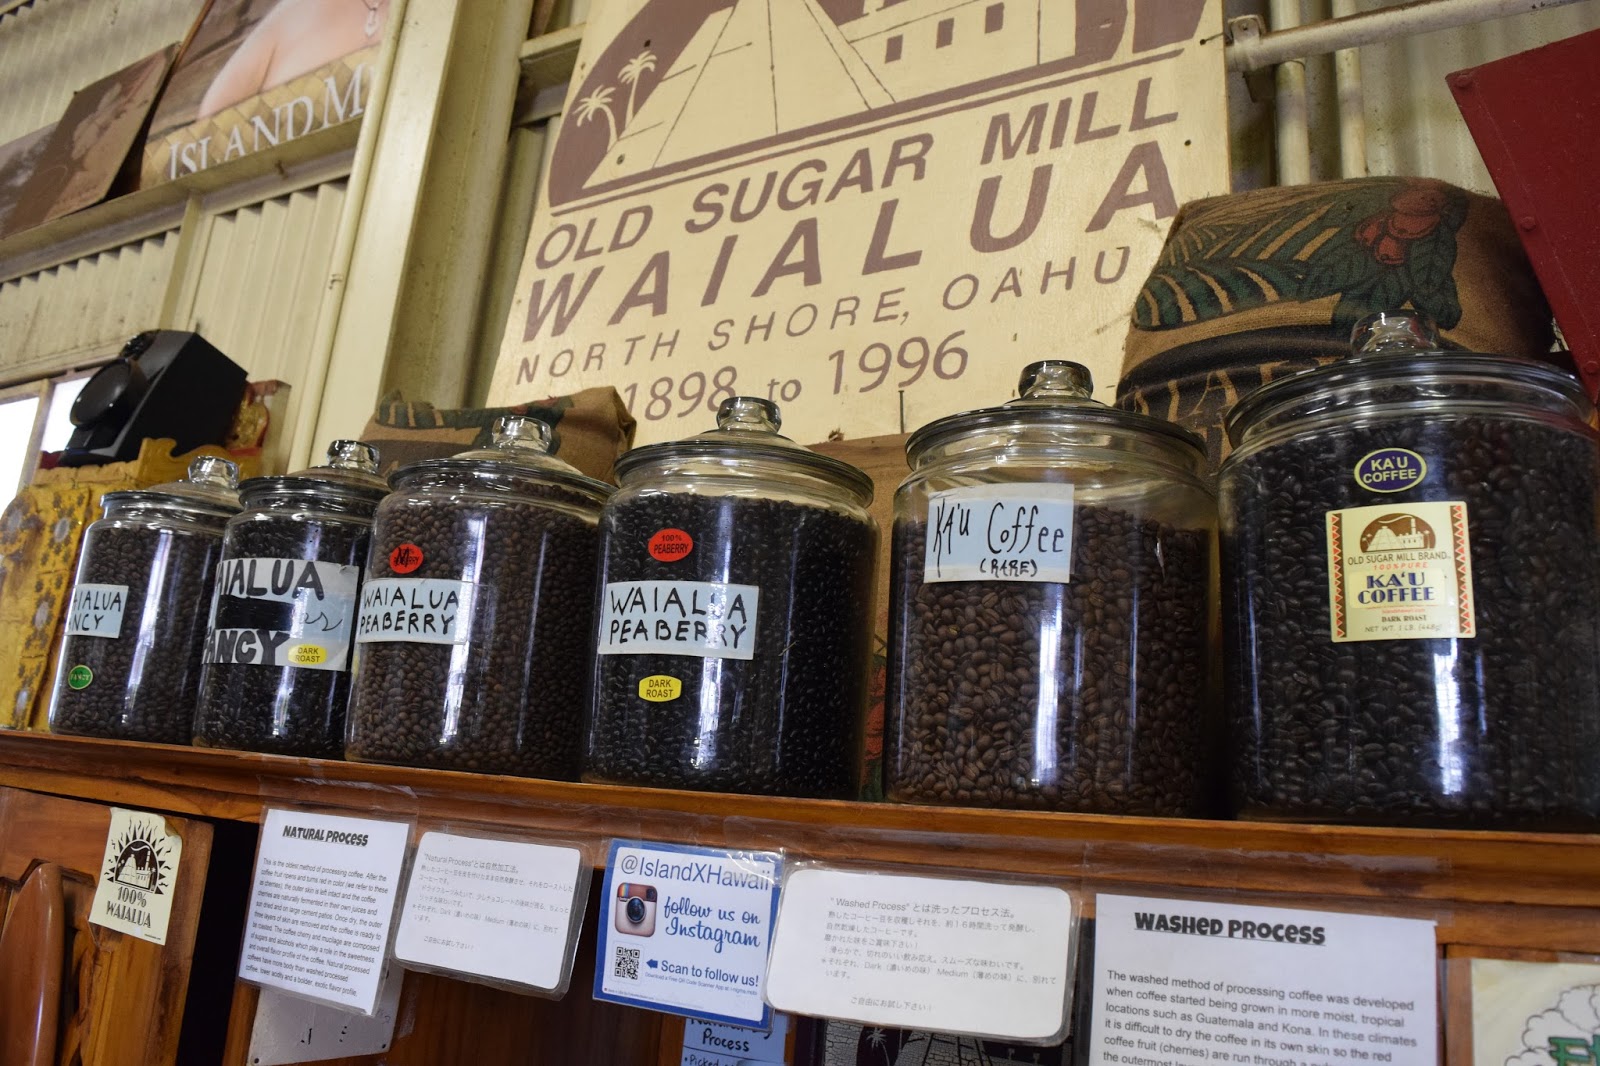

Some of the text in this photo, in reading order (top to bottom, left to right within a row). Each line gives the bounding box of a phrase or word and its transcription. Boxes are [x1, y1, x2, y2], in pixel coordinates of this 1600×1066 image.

[169, 64, 376, 181] ISLAND M
[535, 77, 1179, 270] OLD SUGAR MILL
[522, 140, 1179, 343] WAIALUA
[515, 245, 1131, 385] NORTH SHORE, OAHU
[622, 330, 969, 422] 1898 to 1996
[1363, 468, 1417, 484] COFFEE
[662, 534, 682, 542] 100%
[987, 501, 1065, 554] Coffee
[653, 543, 689, 554] PEABERRY
[1348, 556, 1364, 566] OLD
[1366, 553, 1394, 564] SUGAR
[1397, 552, 1416, 561] MILL
[216, 558, 325, 601] AIALUA
[73, 590, 121, 613] AIALUA
[364, 586, 460, 611] WAIALUA
[1357, 586, 1435, 605] COFFEE
[360, 610, 455, 635] PEABERRY
[1381, 614, 1427, 623] DARK ROAST
[295, 654, 320, 663] ROAST
[297, 646, 319, 655] DARK
[646, 689, 674, 698] ROAST
[649, 679, 671, 688] DARK
[282, 825, 325, 841] NATURAL
[621, 854, 771, 891] @IslandXHawaii
[117, 886, 147, 908] 100%
[105, 900, 152, 929] WAIALUA
[664, 895, 761, 925] follow us on
[665, 916, 761, 954] Instagram
[661, 960, 759, 987] Scan to follow us!
[1107, 969, 1414, 1010] The washed method of processing coffee was developed
[1106, 986, 1132, 997] when
[1135, 990, 1166, 1001] coffee
[1170, 994, 1205, 1006] started
[1208, 997, 1237, 1012] being
[1240, 1003, 1274, 1013] grown
[1277, 1005, 1287, 1015] in
[1290, 1008, 1319, 1018] more
[1361, 1014, 1404, 1027] tropical
[1105, 1002, 1149, 1016] locations
[1152, 1009, 1177, 1019] such
[1180, 1012, 1192, 1021] as
[1195, 1012, 1254, 1028] Guatemala
[1257, 1022, 1278, 1031] and
[1318, 1026, 1329, 1037] In
[1332, 1028, 1364, 1041] these
[1368, 1033, 1417, 1046] climates
[702, 1027, 750, 1052] Process
[1103, 1036, 1134, 1047] coffee
[1137, 1038, 1156, 1051] fruit
[1159, 1042, 1209, 1059] (cherries)
[1211, 1051, 1229, 1060] are
[1232, 1053, 1250, 1062] run
[1104, 1018, 1392, 1062] it is difficult to dry the coffee in its own skin so the red
[1103, 1051, 1119, 1064] the
